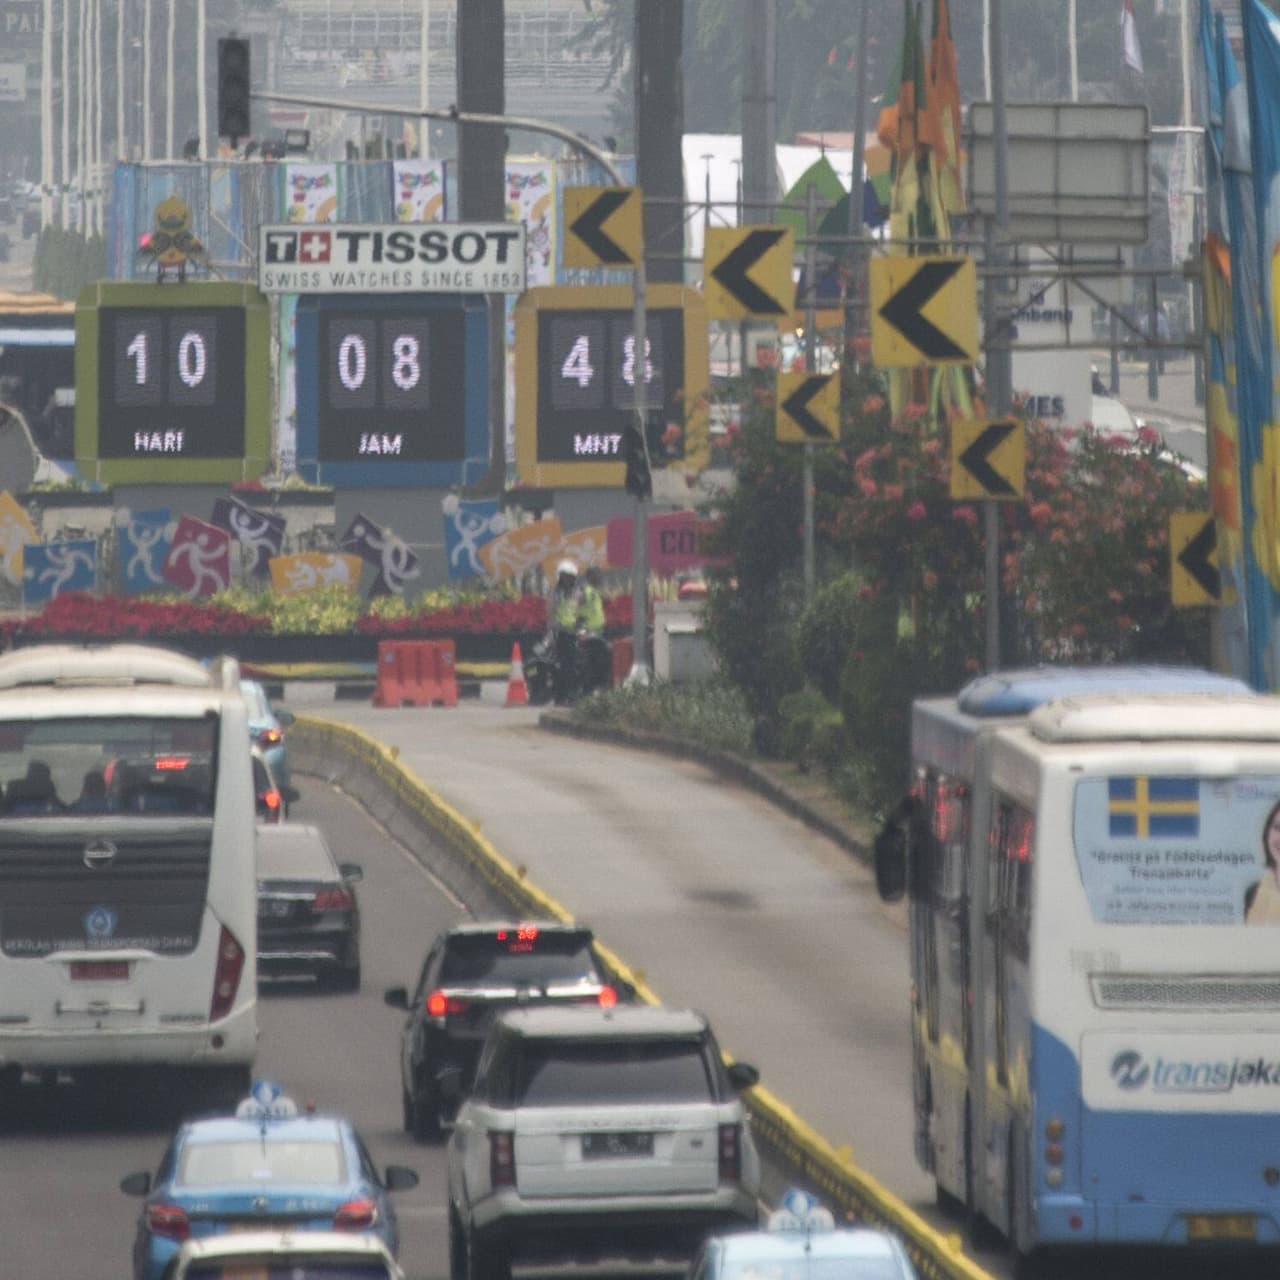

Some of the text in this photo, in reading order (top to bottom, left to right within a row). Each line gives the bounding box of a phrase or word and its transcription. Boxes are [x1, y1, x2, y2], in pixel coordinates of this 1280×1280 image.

[5, 12, 44, 33] PAL
[336, 230, 520, 265] TISSOT
[264, 271, 321, 288] SWISS
[330, 271, 412, 288] WATCHES
[421, 270, 473, 287] SINCE
[126, 333, 207, 388] 10
[337, 334, 422, 390] 08
[134, 431, 185, 452] HARI
[358, 433, 402, 455] JAM
